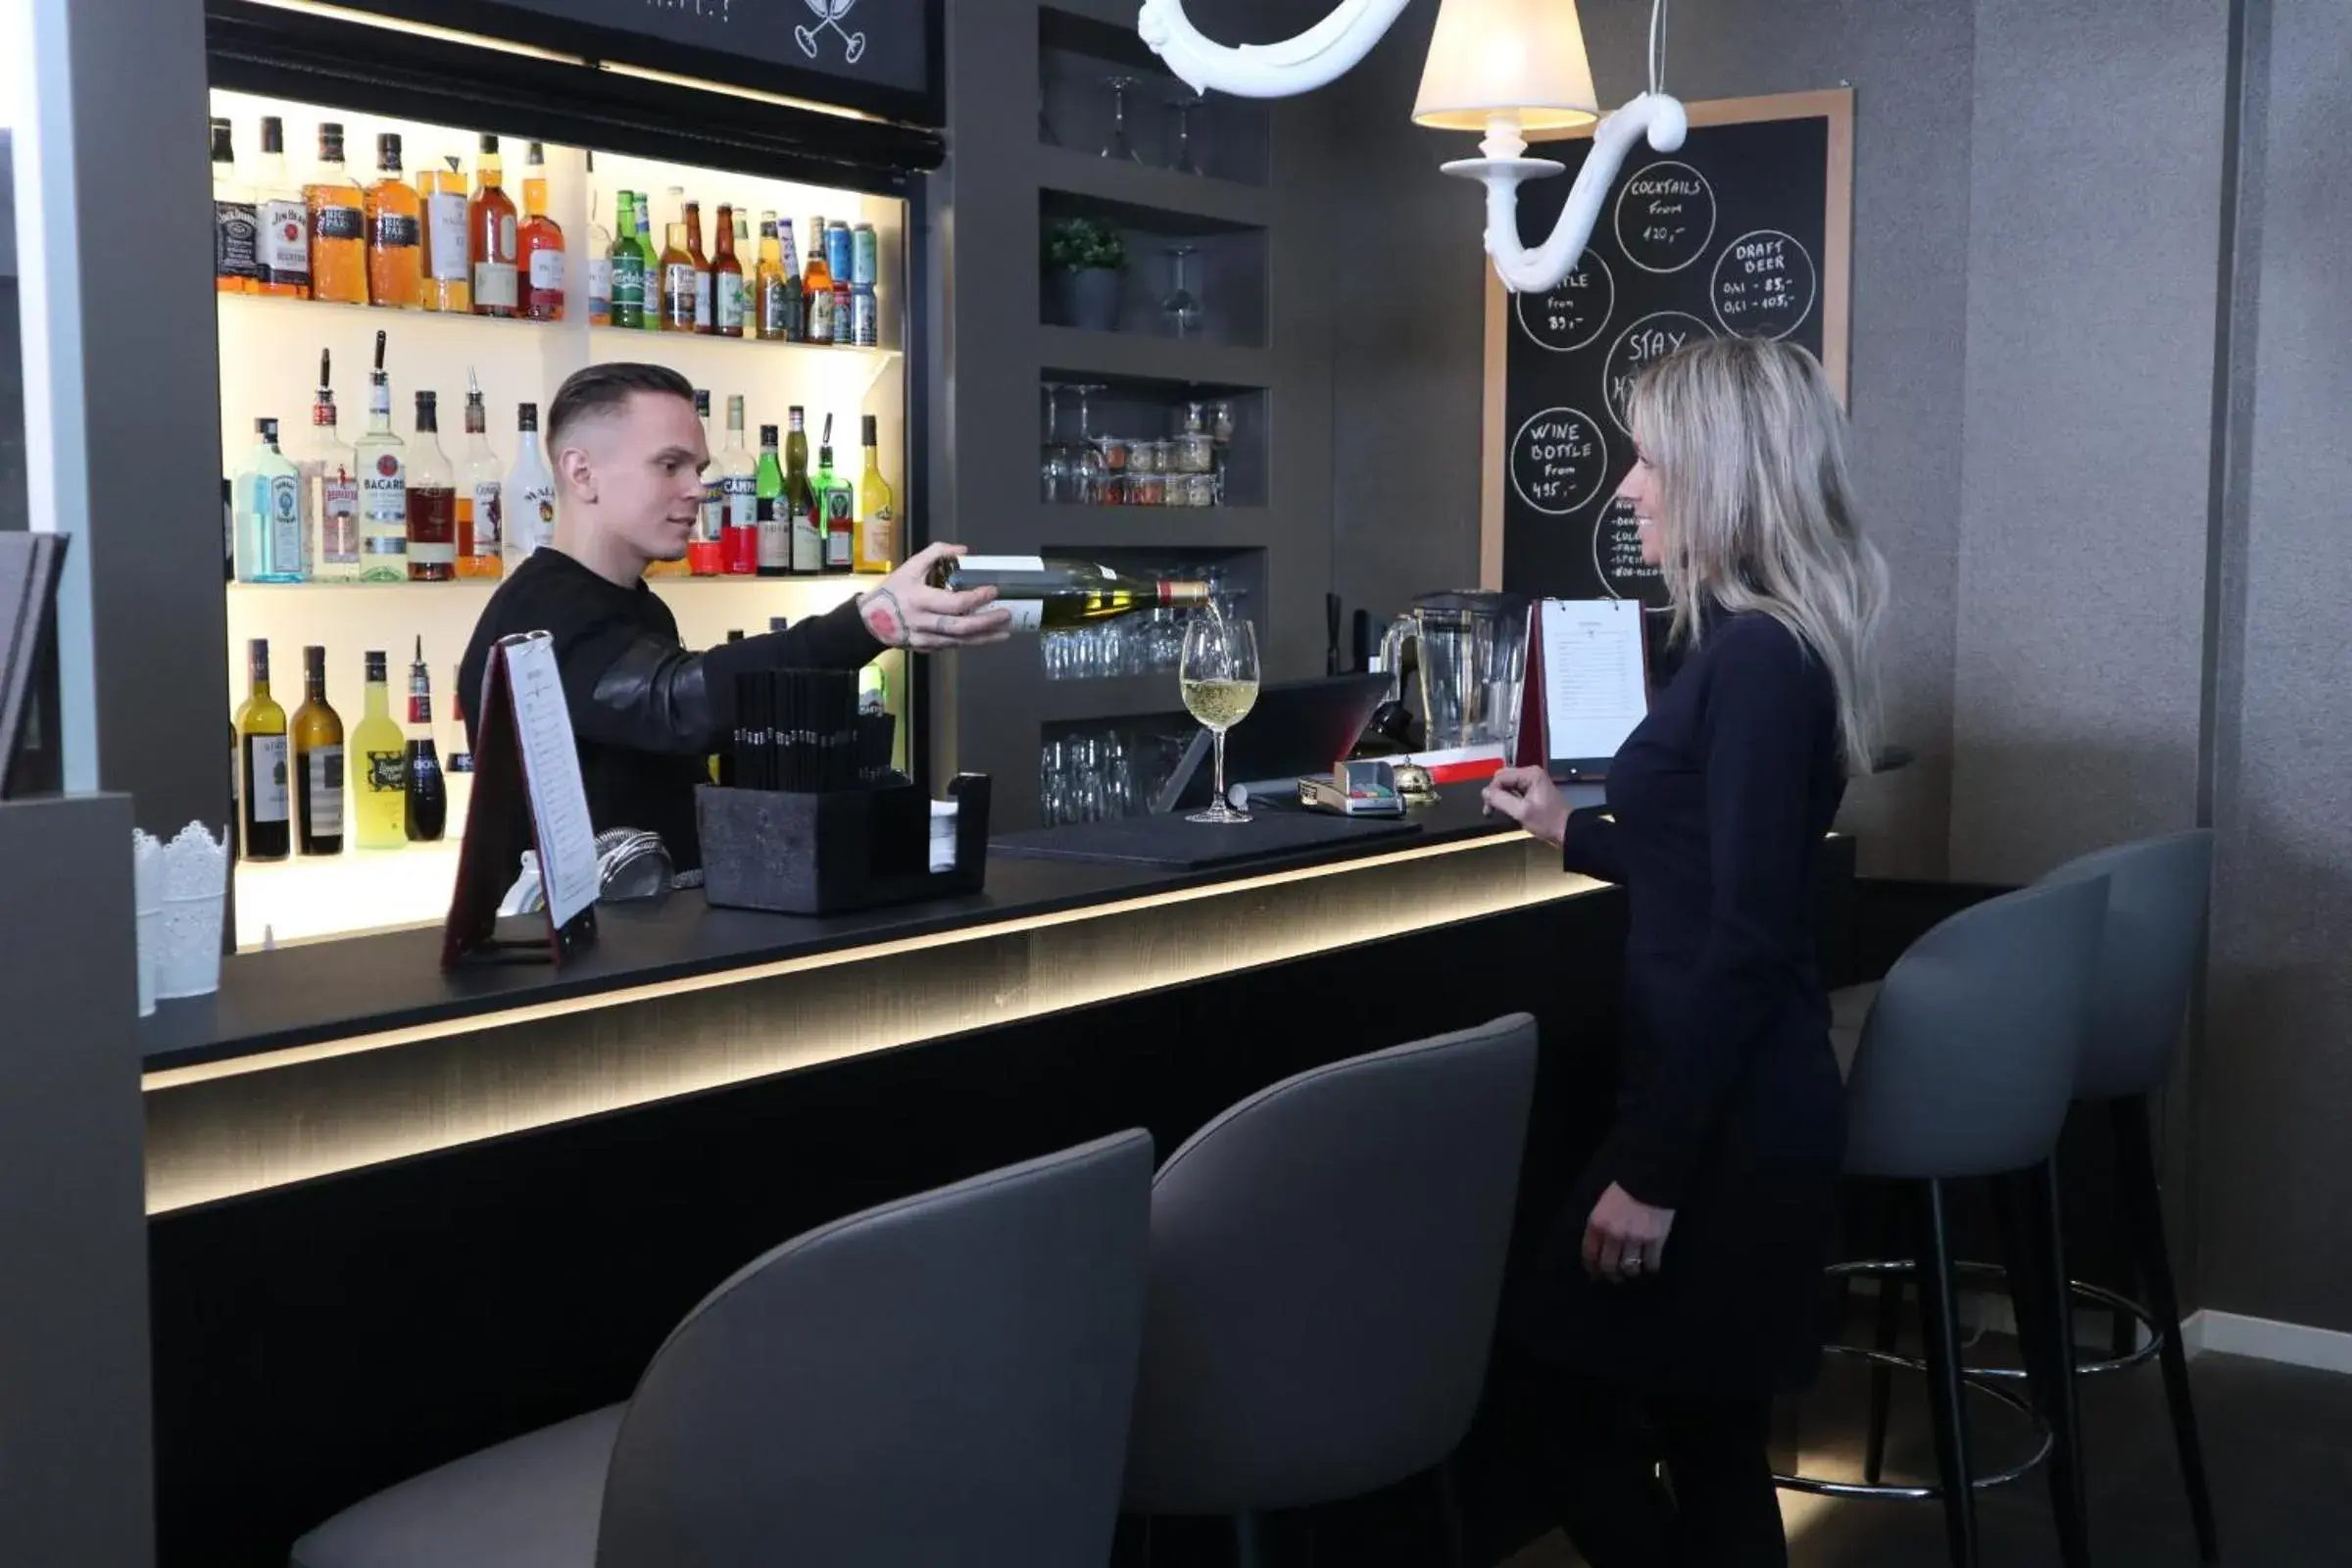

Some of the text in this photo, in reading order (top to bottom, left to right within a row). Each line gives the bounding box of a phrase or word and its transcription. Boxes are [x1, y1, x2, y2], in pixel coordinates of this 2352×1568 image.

[1632, 178, 1701, 195] COCKTAILS
[1737, 239, 1785, 260] DRAFT
[1628, 329, 1687, 361] STAY
[1530, 422, 1580, 441] WINE
[1531, 442, 1592, 461] BOTTLE
